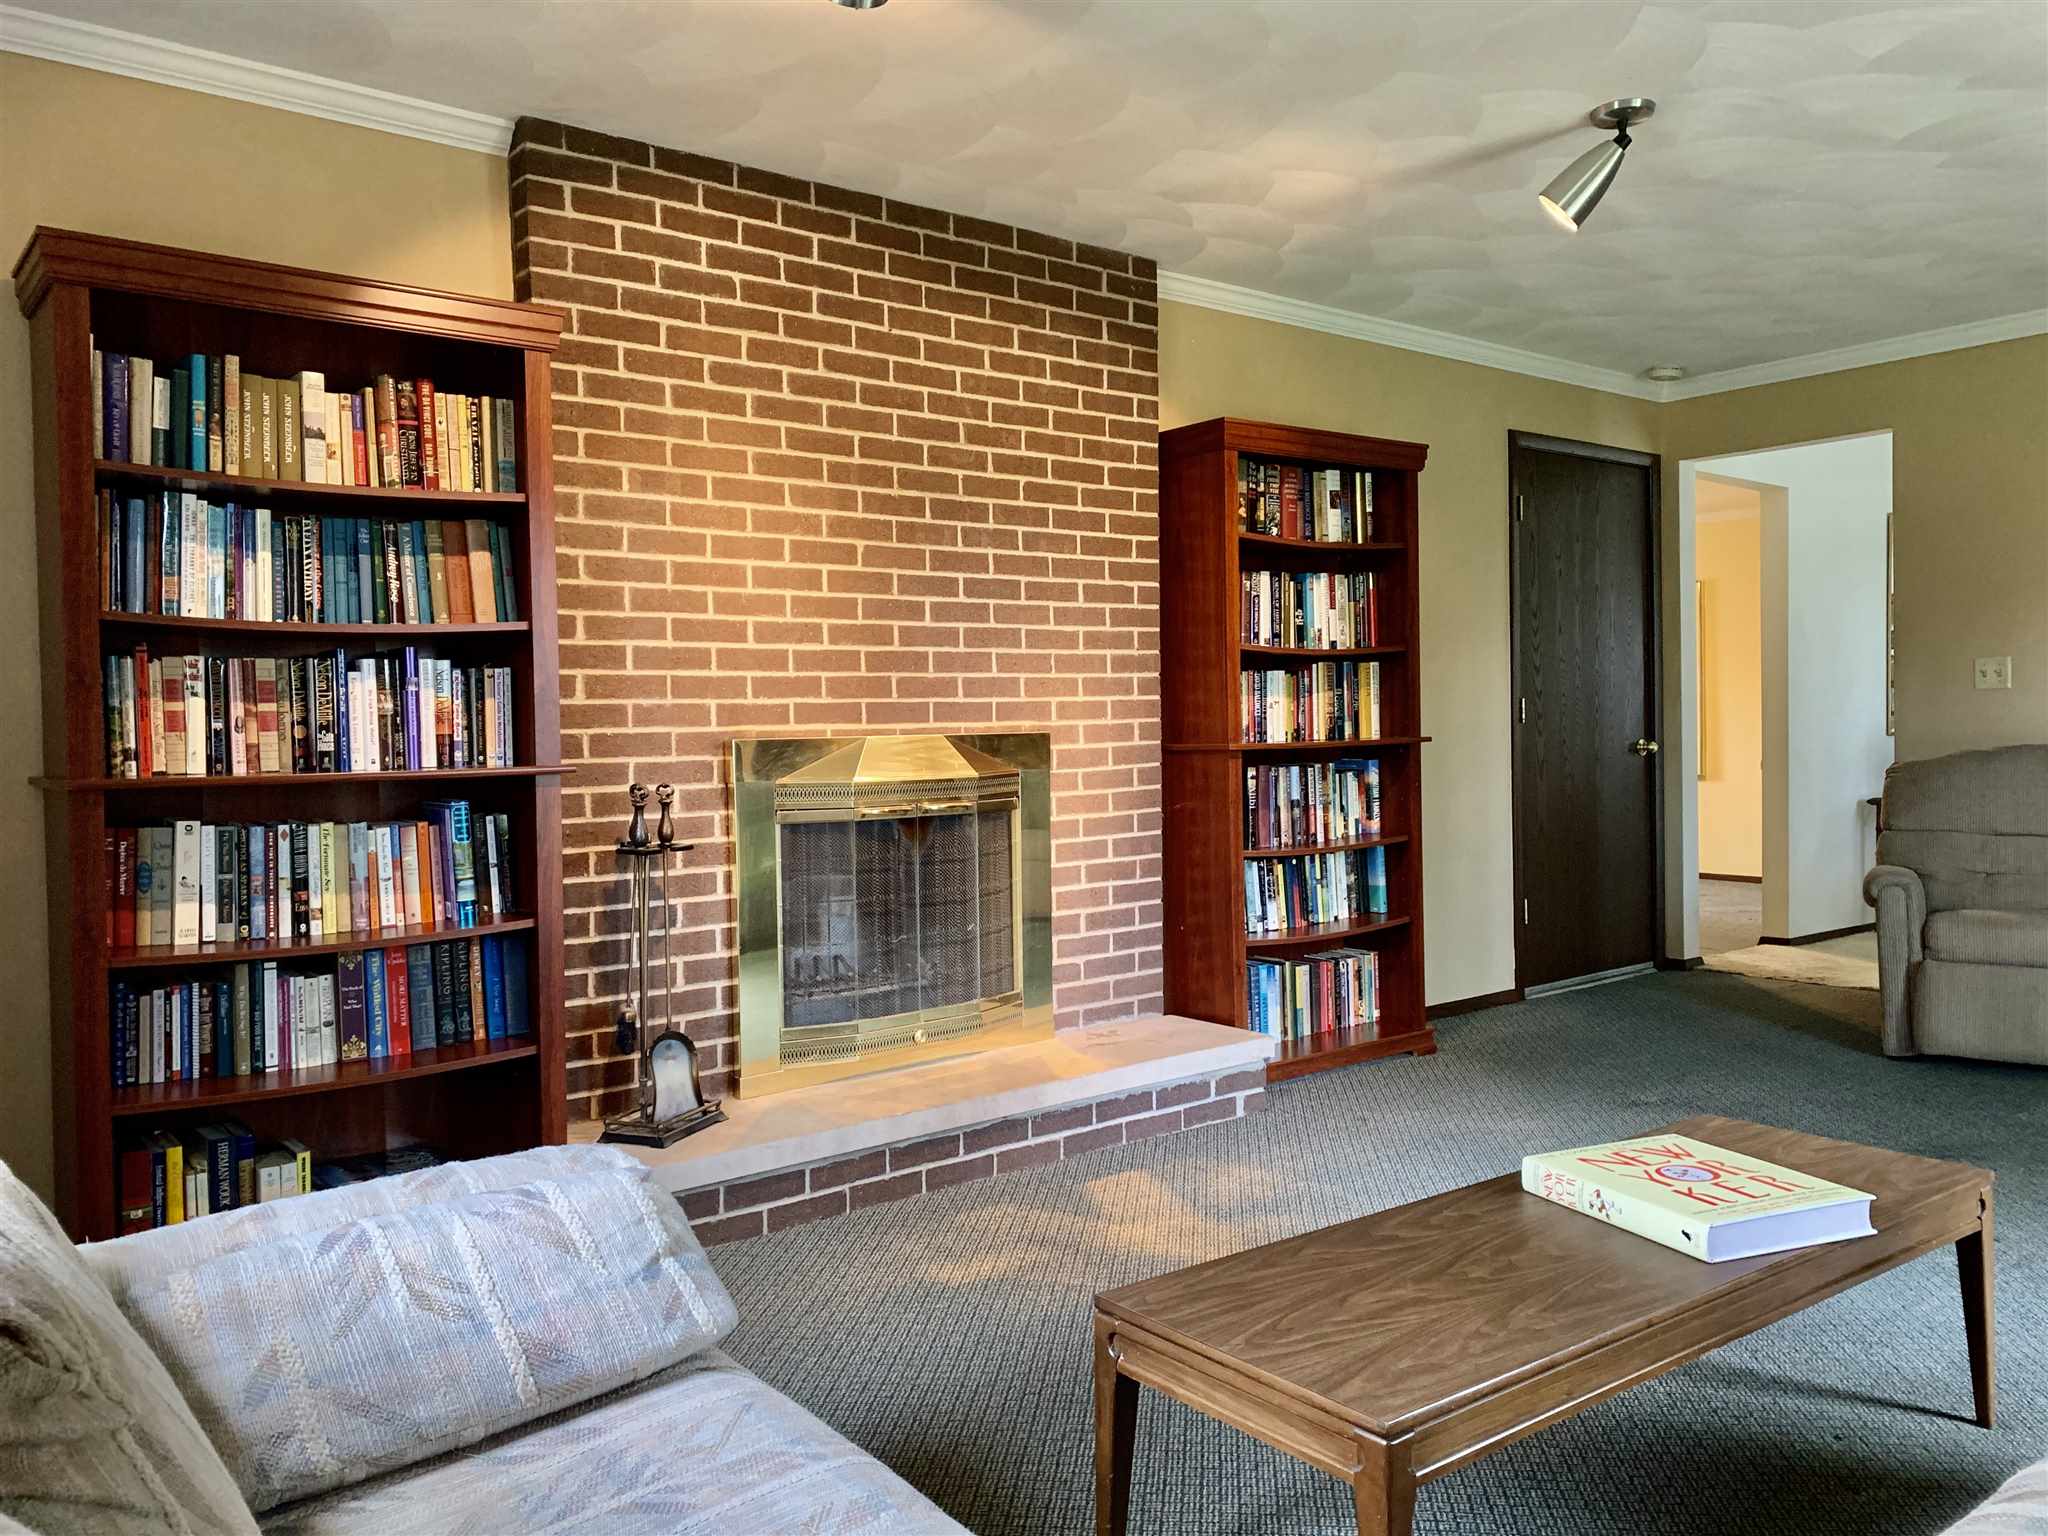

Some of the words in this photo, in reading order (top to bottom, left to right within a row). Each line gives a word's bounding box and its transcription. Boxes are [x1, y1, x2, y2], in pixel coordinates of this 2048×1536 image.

[262, 392, 270, 415] JOHN
[284, 393, 292, 416] JOHN
[243, 414, 251, 460] STEINBECK
[263, 416, 271, 463] STEINBECK
[285, 417, 293, 464] STEINBECK
[303, 519, 312, 556] EVELYN
[387, 543, 398, 579] Audrey
[304, 559, 313, 602] ANTHONY
[390, 578, 400, 602] Rose
[293, 660, 305, 688] Nelson
[316, 659, 331, 690] Nelson
[435, 669, 449, 694] Nelson
[295, 690, 306, 722] DeMille
[317, 691, 333, 726] DeMille
[239, 828, 248, 872] NICHOLAS
[294, 854, 307, 879] BROWN
[240, 874, 248, 906] SPARKS
[371, 956, 380, 977] The
[440, 944, 451, 994] KIPLING
[456, 942, 467, 992] KIPLING
[473, 946, 481, 977] DEWEY
[372, 979, 381, 1015] Walled
[372, 1016, 382, 1037] City
[217, 1141, 230, 1180] HERMAN
[1577, 1143, 1697, 1172] NEW
[219, 1180, 231, 1207] WOUK
[1671, 1175, 1815, 1207] KER
